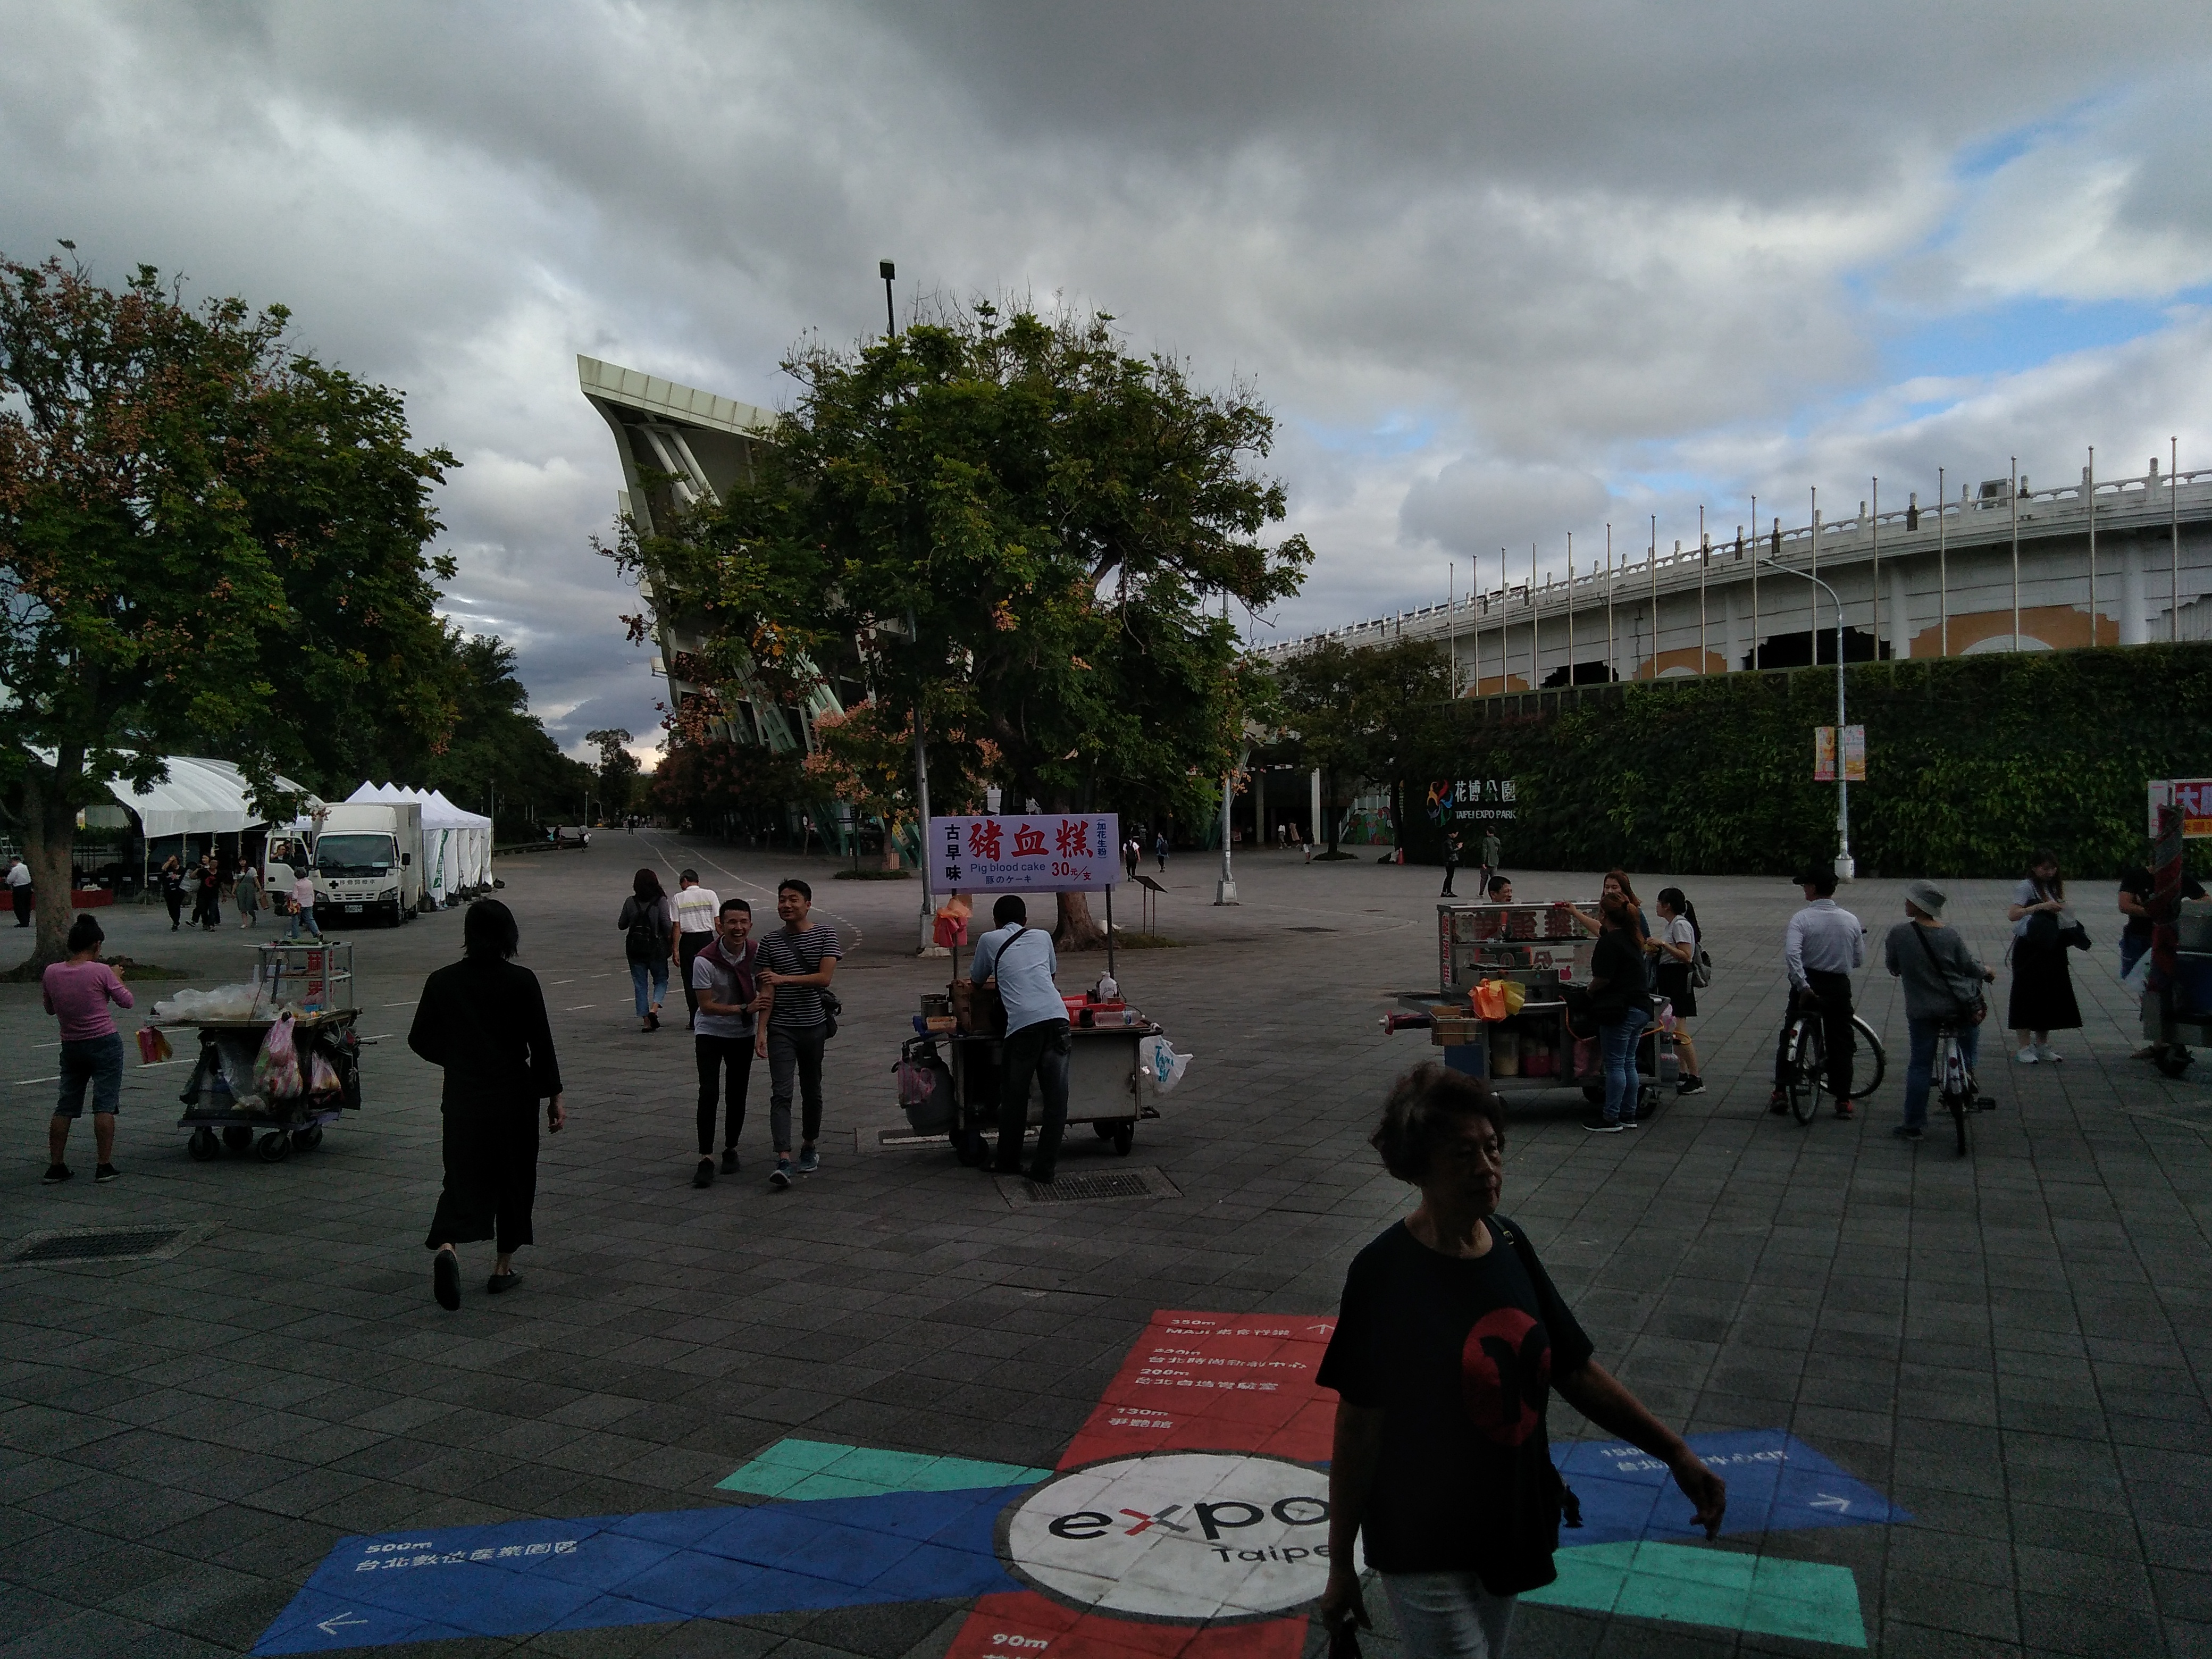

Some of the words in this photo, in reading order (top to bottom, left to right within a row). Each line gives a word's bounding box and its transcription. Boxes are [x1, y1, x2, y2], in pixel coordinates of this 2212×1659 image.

[1455, 780, 1515, 802] 花博公園
[1455, 810, 1474, 819] TAIPEI
[1476, 810, 1495, 819] EXPO
[1496, 810, 1516, 819] PARK
[968, 819, 1093, 862] 豬血糕
[945, 824, 961, 881] 古早味
[970, 864, 987, 874] Pig
[990, 862, 1018, 872] blood
[1021, 862, 1045, 871] cake
[1051, 862, 1091, 881] 30元/支
[986, 875, 1032, 884] 豚のケーキ
[1117, 1408, 1169, 1417] 130m
[1601, 1448, 1645, 1456] 150
[1049, 1496, 1329, 1540] expo
[365, 1541, 432, 1554] 500m
[1212, 1544, 1329, 1564] Taipe
[992, 1633, 1048, 1650] 90m
